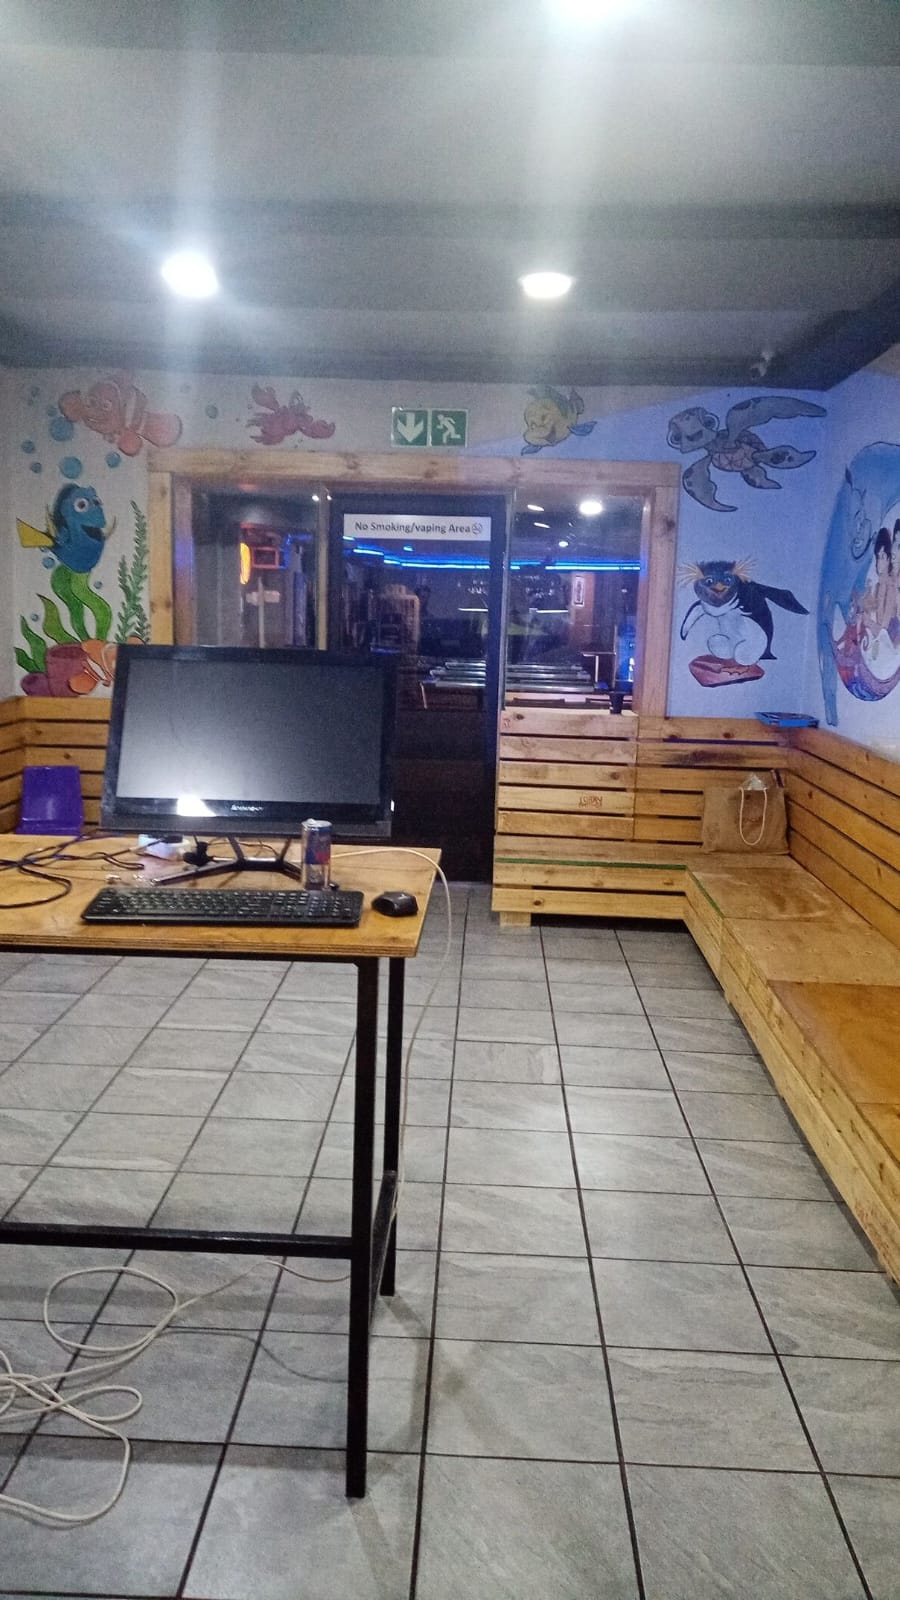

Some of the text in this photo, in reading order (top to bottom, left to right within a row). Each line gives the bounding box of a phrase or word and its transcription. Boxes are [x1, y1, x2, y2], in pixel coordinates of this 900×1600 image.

[354, 521, 471, 534] No Smoking/vaping Area
